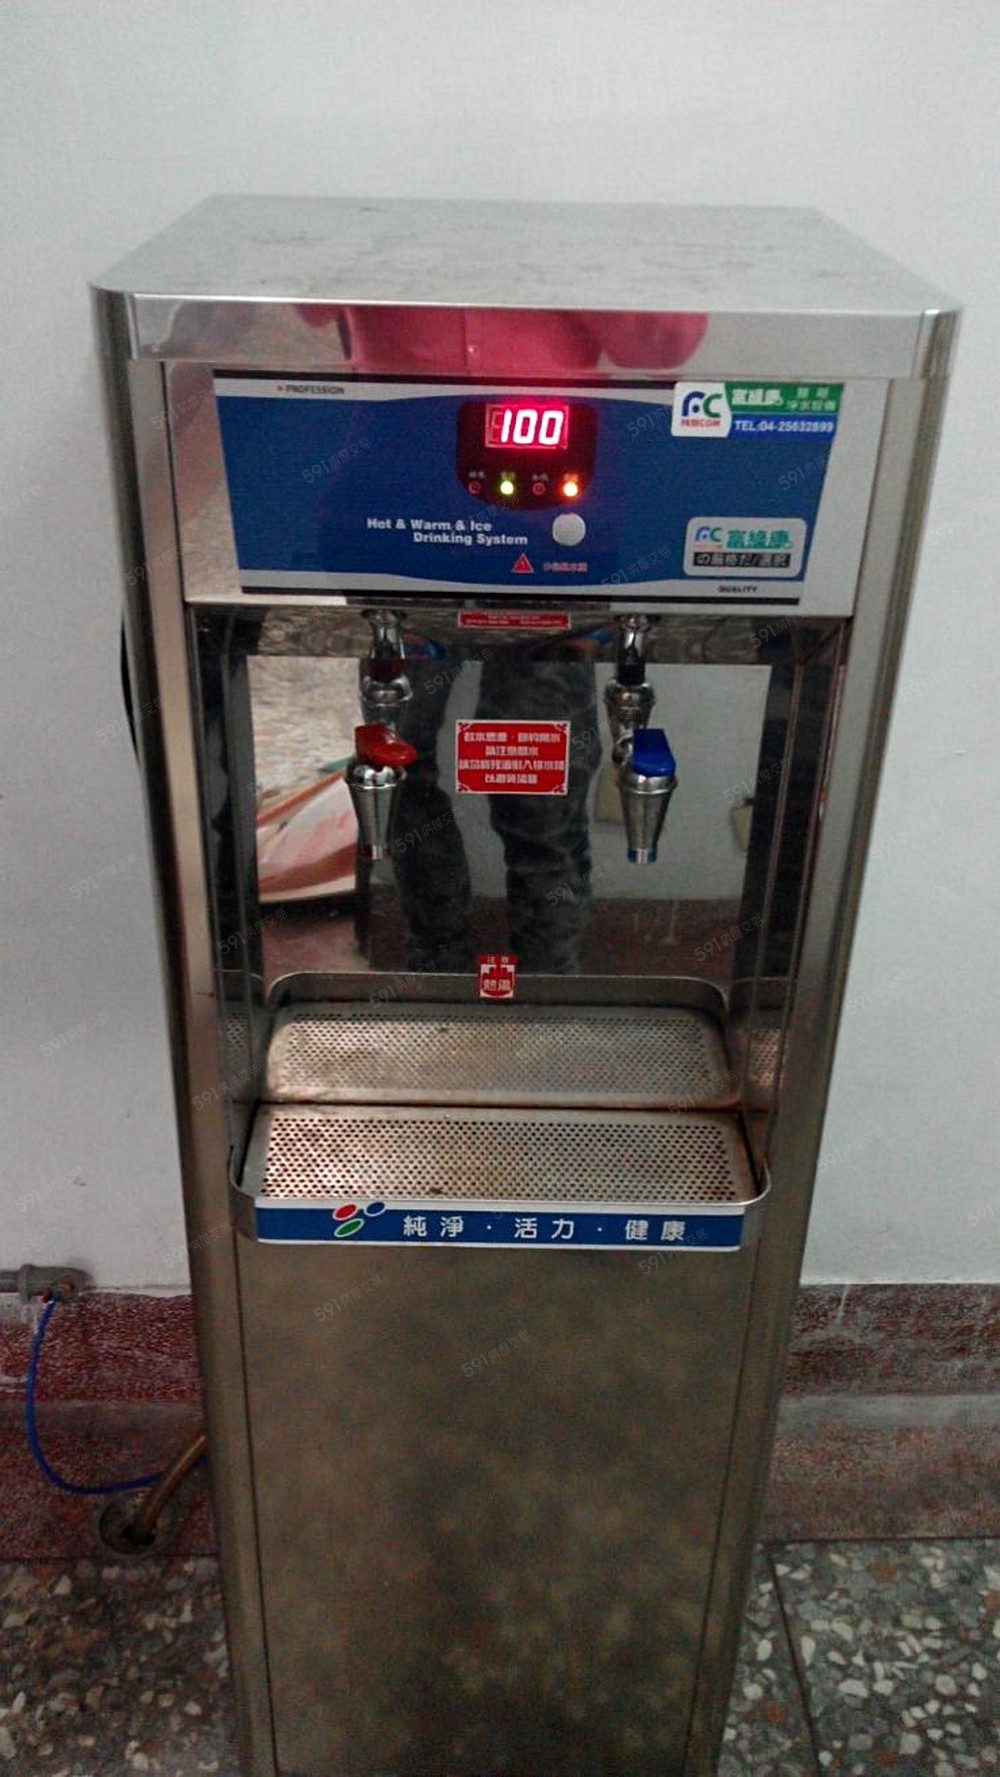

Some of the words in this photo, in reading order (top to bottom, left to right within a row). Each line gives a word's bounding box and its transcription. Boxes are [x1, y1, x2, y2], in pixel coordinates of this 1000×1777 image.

[500, 408, 564, 445] 100
[367, 518, 391, 529] Hot
[395, 518, 406, 530] &
[410, 519, 451, 530] Warm
[455, 520, 465, 531] &
[470, 520, 492, 532] Ice
[413, 532, 473, 546] Drinking
[477, 533, 528, 547] System
